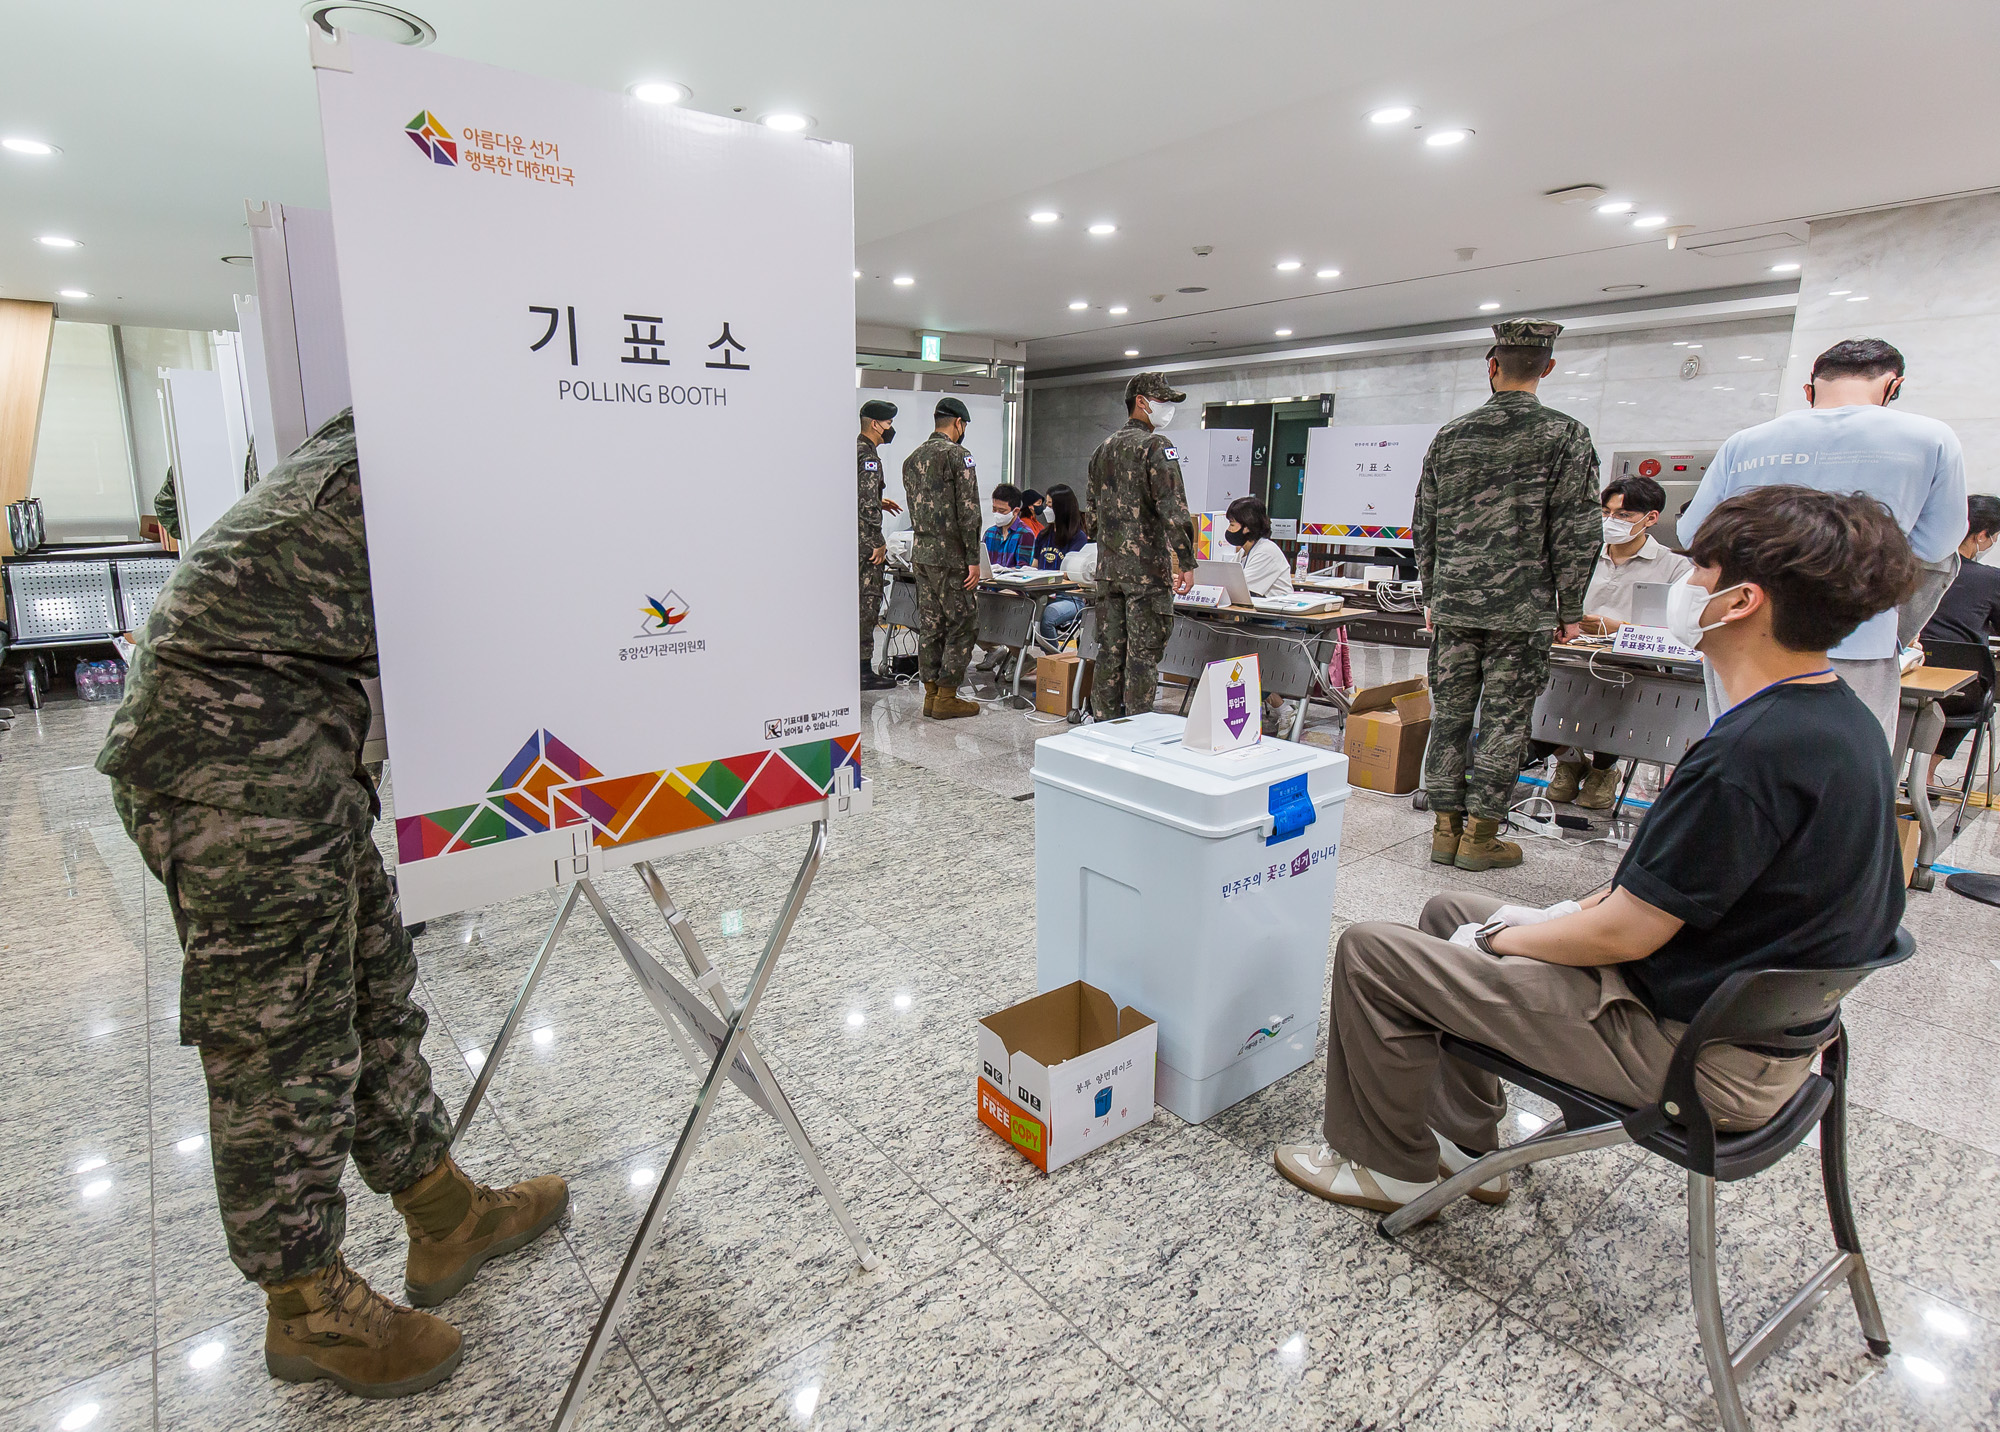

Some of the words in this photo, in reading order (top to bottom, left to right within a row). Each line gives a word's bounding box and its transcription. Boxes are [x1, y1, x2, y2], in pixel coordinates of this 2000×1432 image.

[463, 127, 526, 156] 아름다운
[530, 139, 559, 162] 선거
[464, 150, 512, 176] 행복한
[516, 159, 576, 187] 대한민국
[559, 380, 652, 404] POLLING
[658, 384, 727, 407] BOOTH
[1729, 453, 1810, 474] LIMITED
[1619, 640, 1656, 652] 투표용지
[1656, 644, 1666, 653] 등
[1667, 645, 1687, 655] 받는
[1622, 632, 1654, 642] 본인확인
[618, 639, 706, 662] 중앙선거관리위원회
[1228, 696, 1246, 710] 투입구
[783, 714, 809, 726] 기표대를
[831, 707, 850, 718] 기대면
[783, 725, 803, 737] 넘어질
[804, 724, 811, 733] 수
[813, 719, 840, 731] 있습니다.
[1222, 872, 1262, 898] 민주주의
[1266, 863, 1287, 882] 꽃은
[1075, 1079, 1092, 1094] 봉투
[1095, 1059, 1133, 1085] 양면테이프
[982, 1094, 1010, 1129] FREE
[1012, 1119, 1039, 1149] COPY
